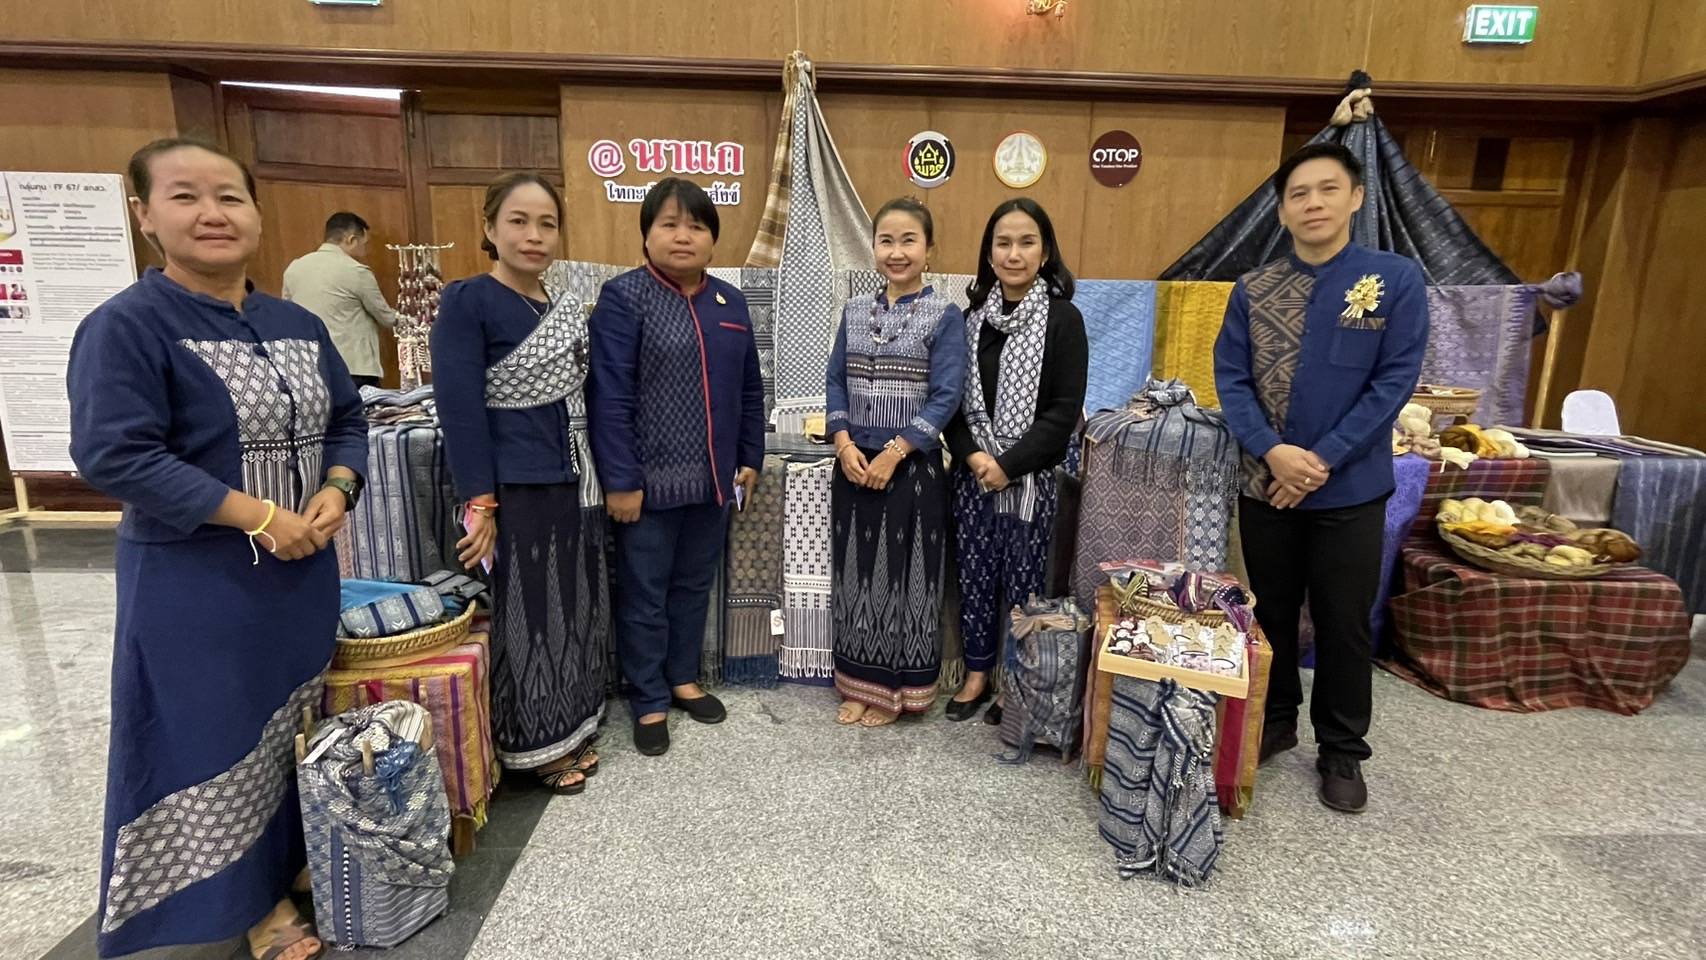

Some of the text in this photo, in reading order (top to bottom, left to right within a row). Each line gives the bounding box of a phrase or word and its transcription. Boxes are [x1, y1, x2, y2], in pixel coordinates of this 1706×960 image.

[1474, 9, 1533, 36] EXIT
[590, 140, 744, 176] @ นาแก
[1092, 148, 1139, 162] OTOP
